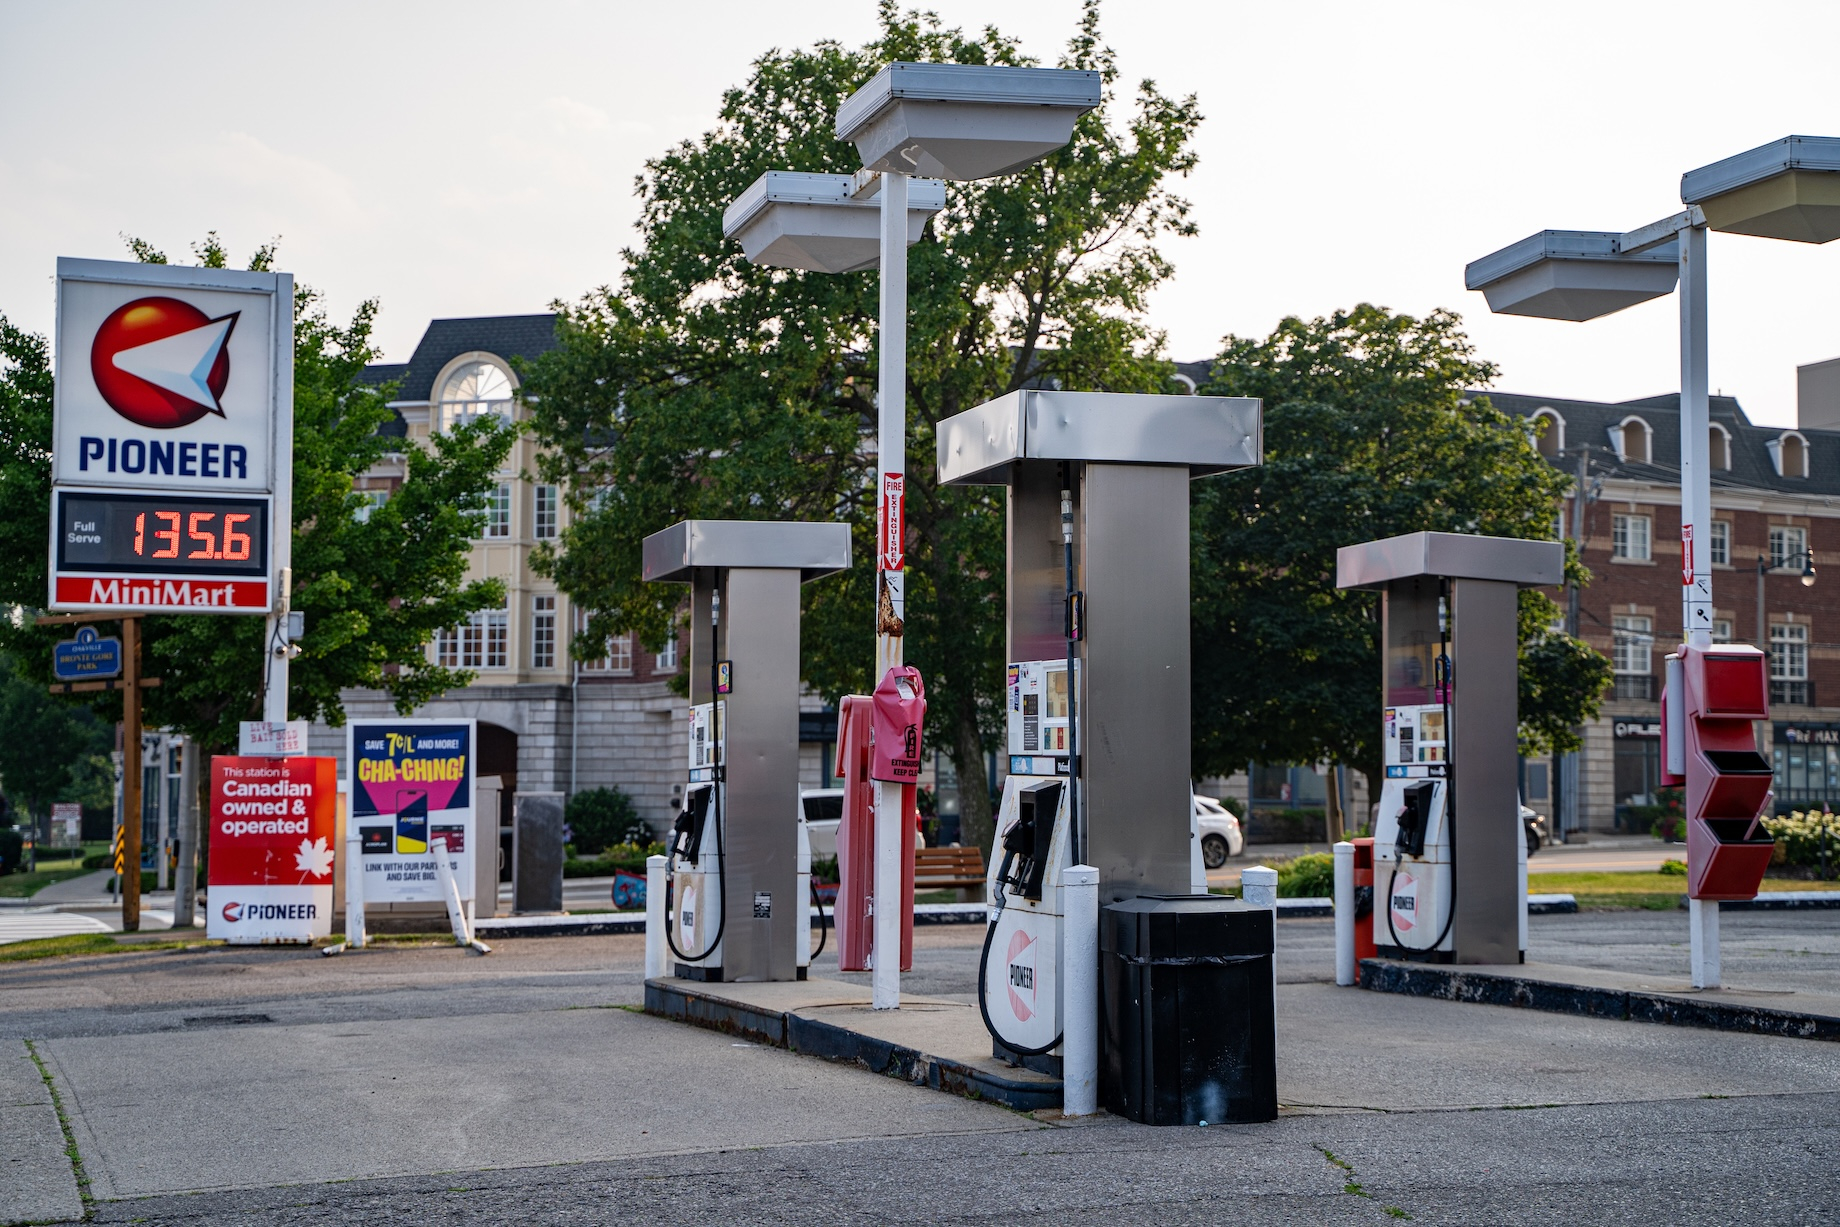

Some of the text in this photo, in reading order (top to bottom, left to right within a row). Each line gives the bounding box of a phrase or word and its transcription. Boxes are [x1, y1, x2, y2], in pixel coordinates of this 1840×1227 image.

[79, 436, 247, 479] PIONEER
[886, 481, 902, 491] FIRE
[73, 521, 95, 532] Full
[67, 532, 101, 544] Serve
[89, 578, 236, 607] MiniMart
[76, 663, 97, 671] PARK
[250, 722, 273, 732] LIVE
[250, 730, 298, 743] BAIT SOLD
[275, 741, 299, 751] HERE
[364, 740, 385, 751] SAVE
[417, 740, 433, 749] AND
[434, 739, 460, 749] MORE!
[223, 767, 290, 777] This station is
[358, 755, 466, 783] CHA-CHING!
[893, 768, 908, 776] KEEP
[222, 780, 312, 797] Canadian
[222, 799, 306, 816] owned &
[221, 817, 309, 837] operated
[365, 863, 381, 872] LINK
[384, 862, 402, 871] WITH
[404, 862, 420, 871] OUR
[386, 872, 437, 881] AND SAVE BIG.
[1010, 964, 1033, 990] PIONEER
